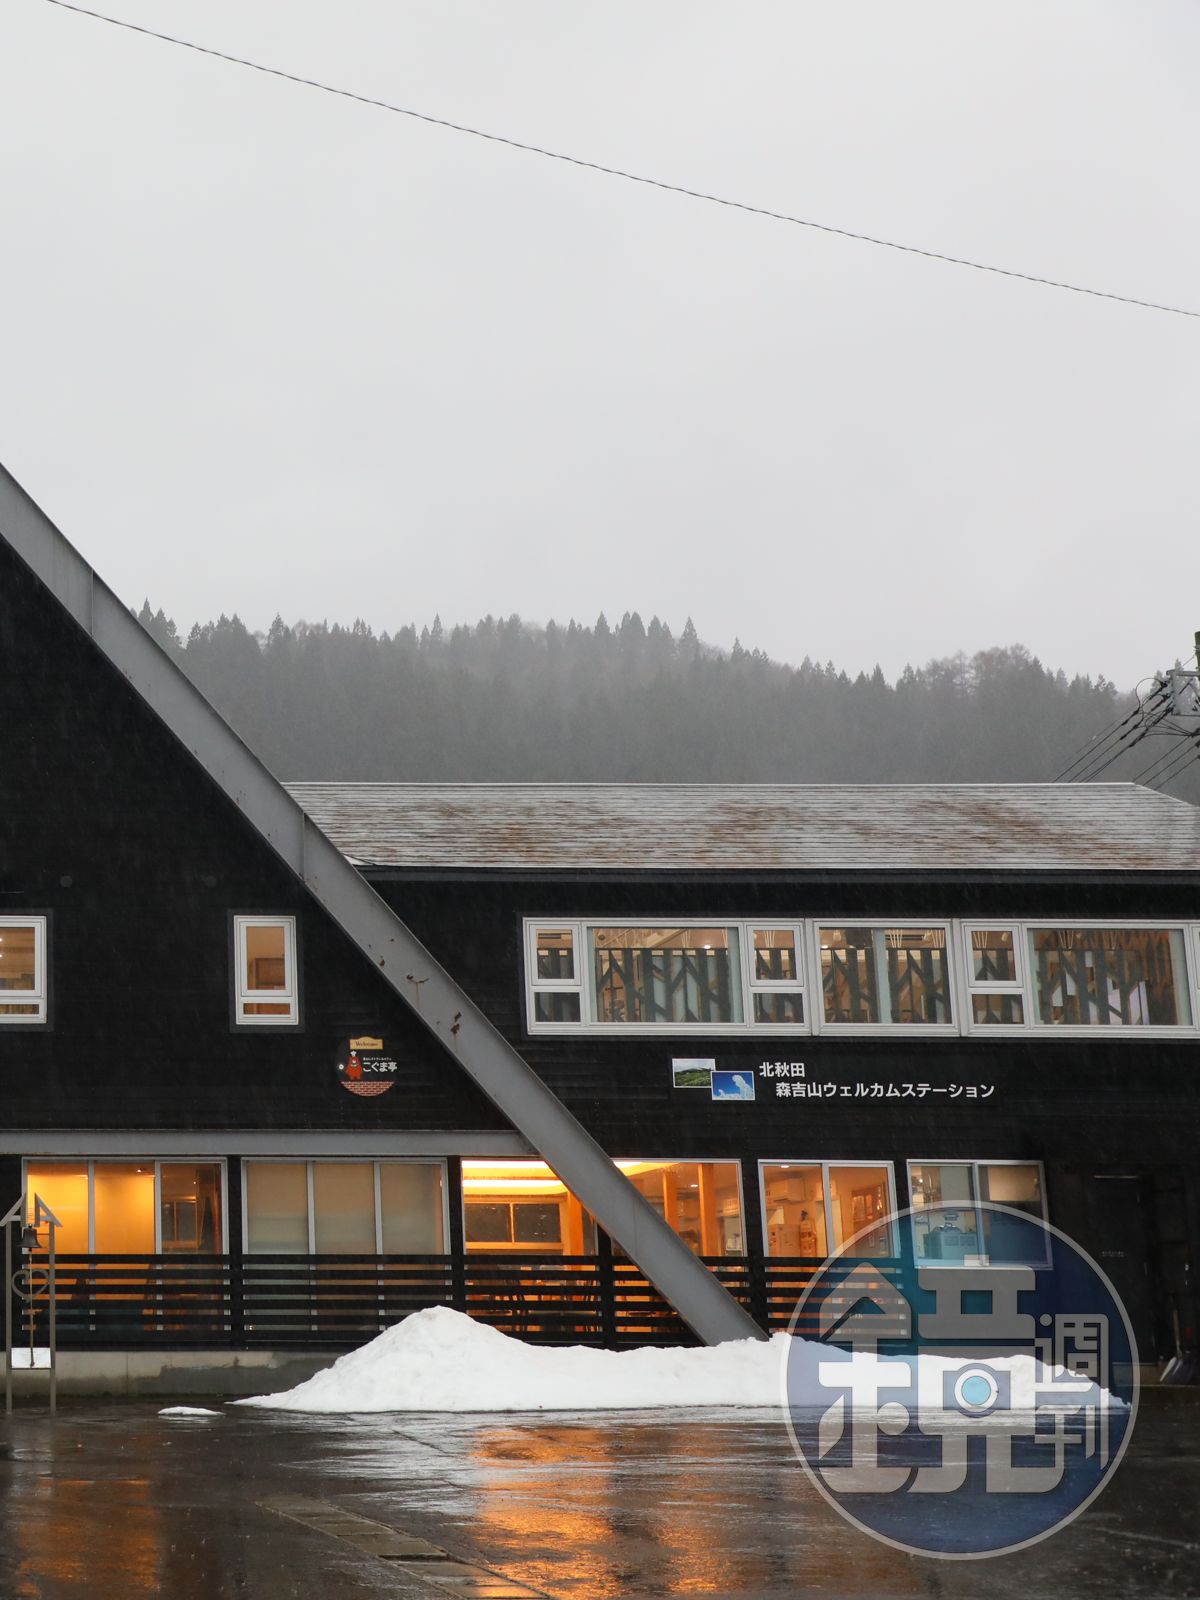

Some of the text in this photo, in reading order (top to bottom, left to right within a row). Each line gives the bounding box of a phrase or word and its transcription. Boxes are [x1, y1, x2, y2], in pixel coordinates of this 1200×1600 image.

[362, 1061, 397, 1072] こぐま亭
[759, 1061, 806, 1078] 北秋田
[775, 1082, 996, 1098] 森吉山ウェルカムステーション
